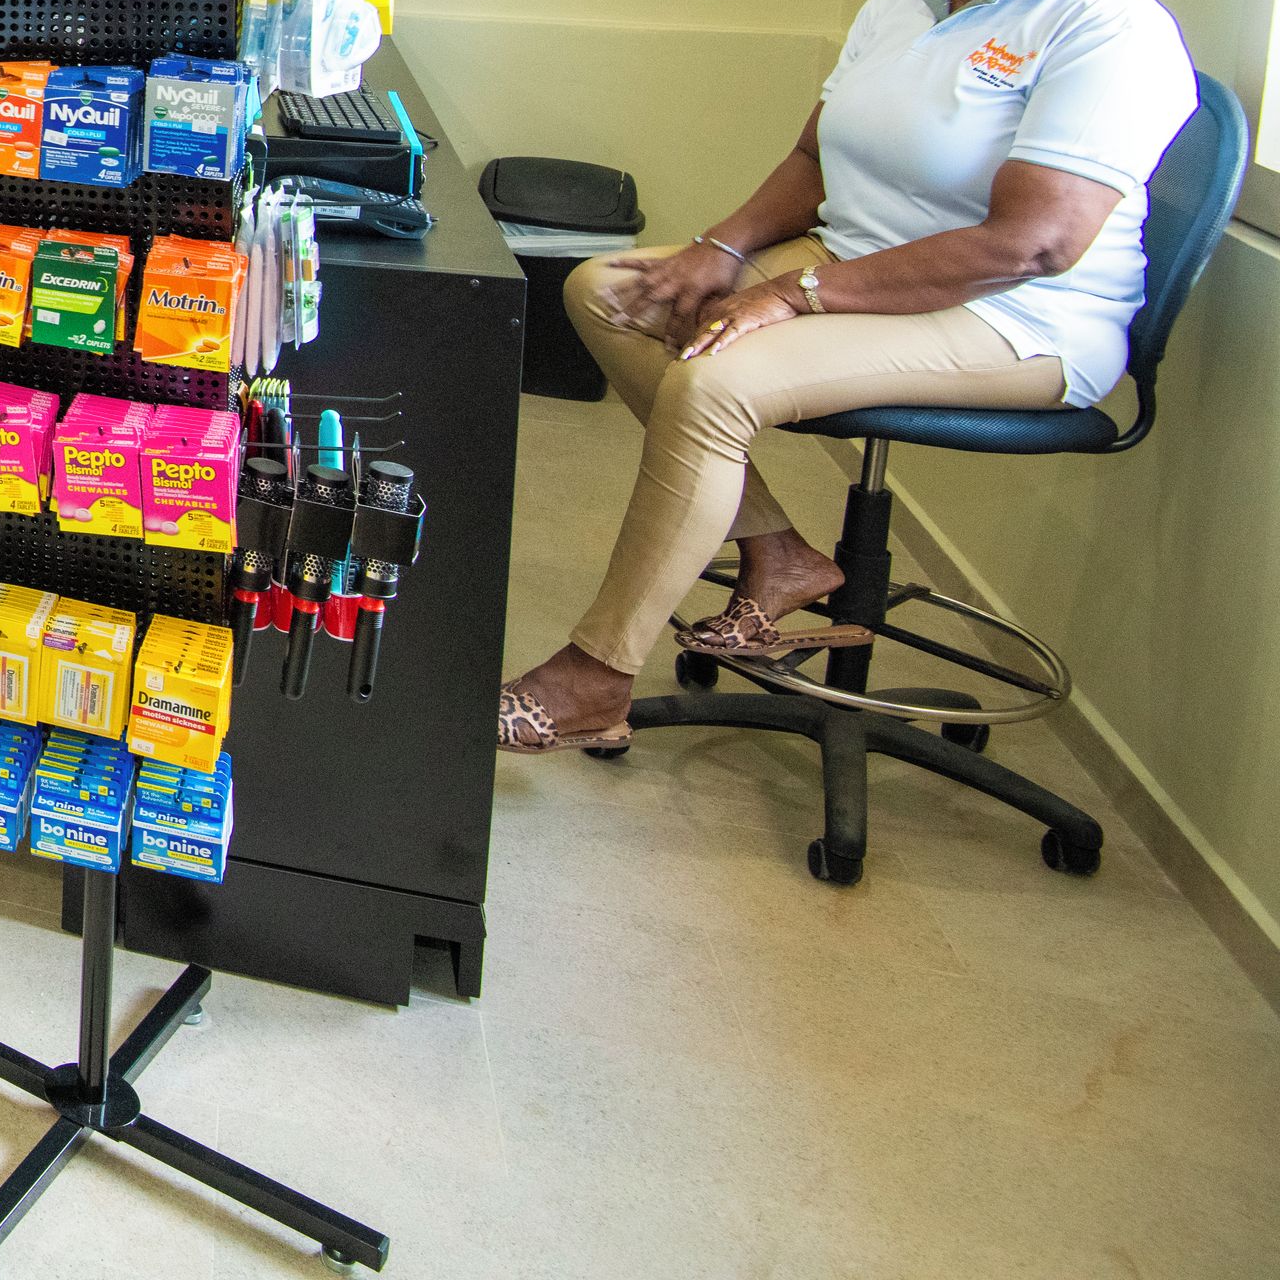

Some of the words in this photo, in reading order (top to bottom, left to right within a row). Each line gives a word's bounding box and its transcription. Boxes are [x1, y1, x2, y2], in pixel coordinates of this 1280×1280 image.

[156, 85, 219, 105] NyQuil
[49, 103, 120, 127] NyQuil
[168, 110, 222, 123] VapoCOOL
[98, 169, 105, 178] 4
[195, 164, 204, 176] 4
[40, 272, 102, 291] EXCEDRIN
[148, 290, 218, 314] Motrin
[78, 333, 85, 344] 2
[86, 339, 111, 350] CAPLETS
[63, 446, 126, 469] Pepto
[65, 464, 106, 476] Bismol
[152, 458, 216, 482] Pepto
[67, 486, 128, 496] CHEWABLES
[153, 476, 194, 489] Bismol
[154, 498, 218, 510] CHEWABLES
[138, 691, 212, 722] Dramamine
[142, 709, 170, 720] motion
[172, 715, 206, 732] sickness
[37, 796, 84, 813] bonine
[139, 806, 187, 825] bonine
[39, 817, 108, 848] bonine
[142, 831, 212, 859] bonine
